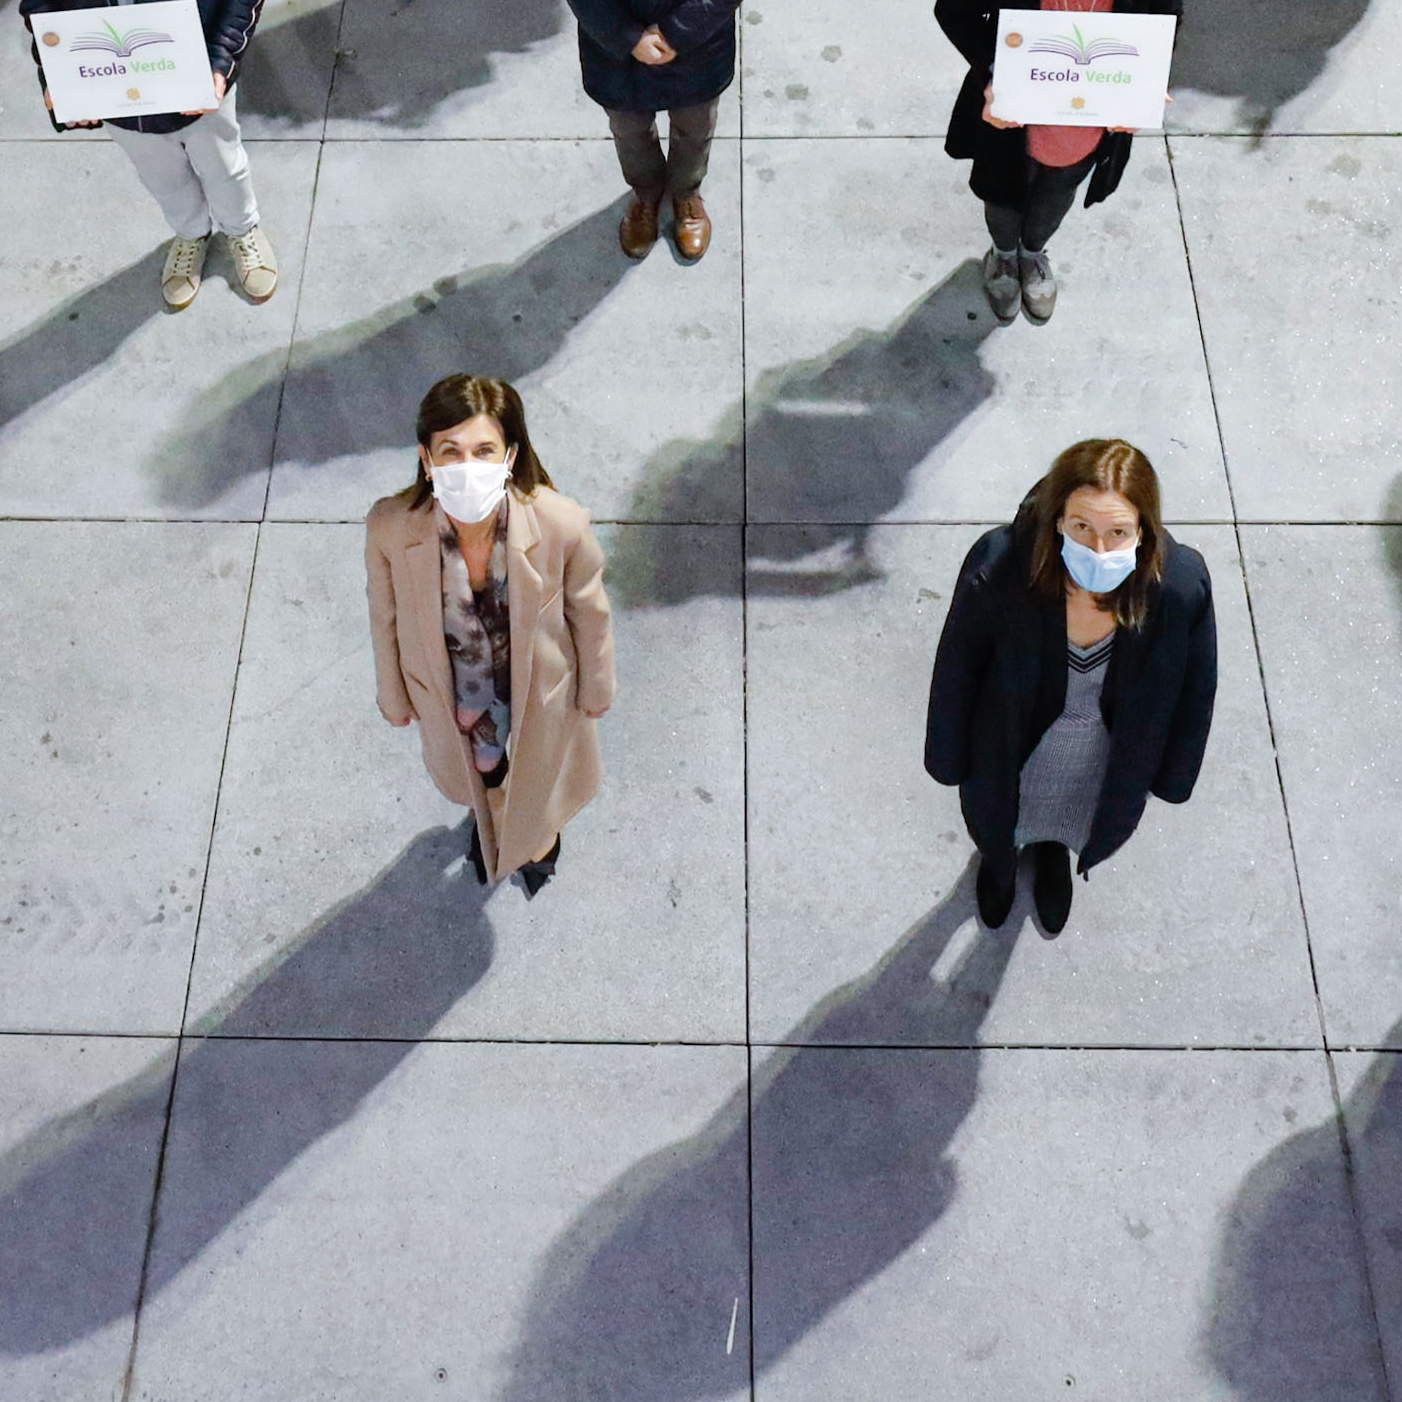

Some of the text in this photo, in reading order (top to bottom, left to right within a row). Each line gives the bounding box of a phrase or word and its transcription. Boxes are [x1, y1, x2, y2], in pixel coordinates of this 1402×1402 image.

[78, 59, 176, 79] Escola Verda
[1030, 69, 1131, 84] Escola Verda
